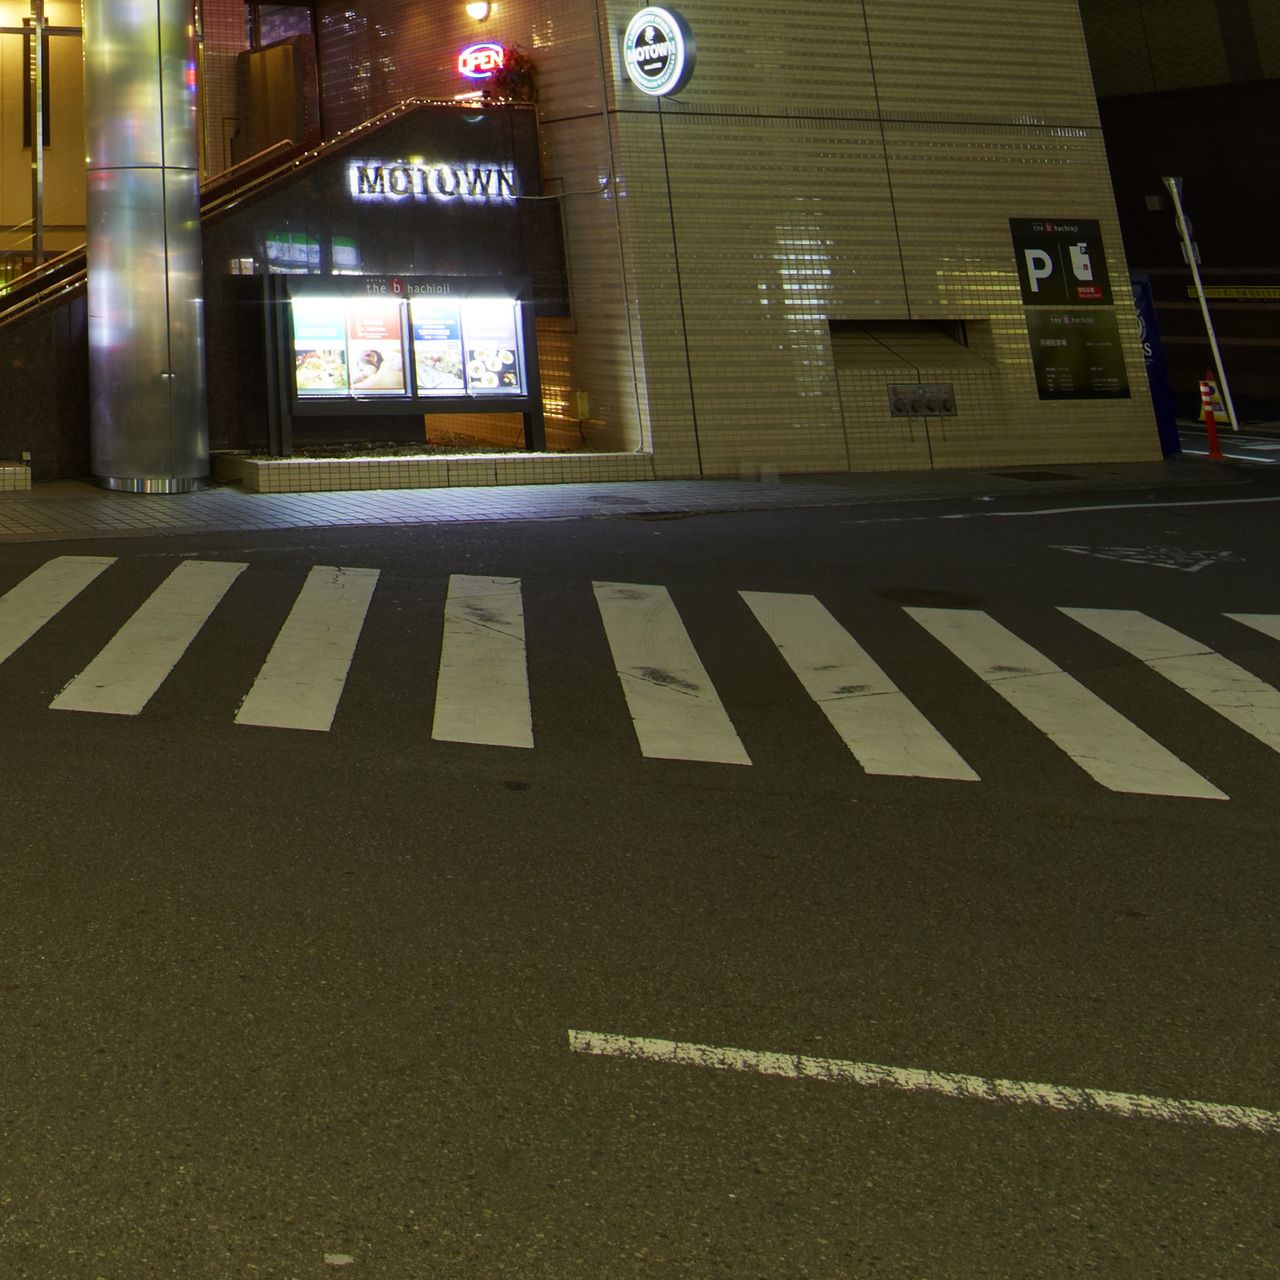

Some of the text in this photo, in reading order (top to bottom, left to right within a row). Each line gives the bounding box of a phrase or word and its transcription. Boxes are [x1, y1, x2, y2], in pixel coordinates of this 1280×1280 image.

[458, 50, 504, 72] OPEN
[627, 40, 676, 62] MOTOWN
[351, 161, 519, 200] MOTOWN
[1024, 248, 1054, 293] P
[366, 279, 450, 295] the b hachioji
